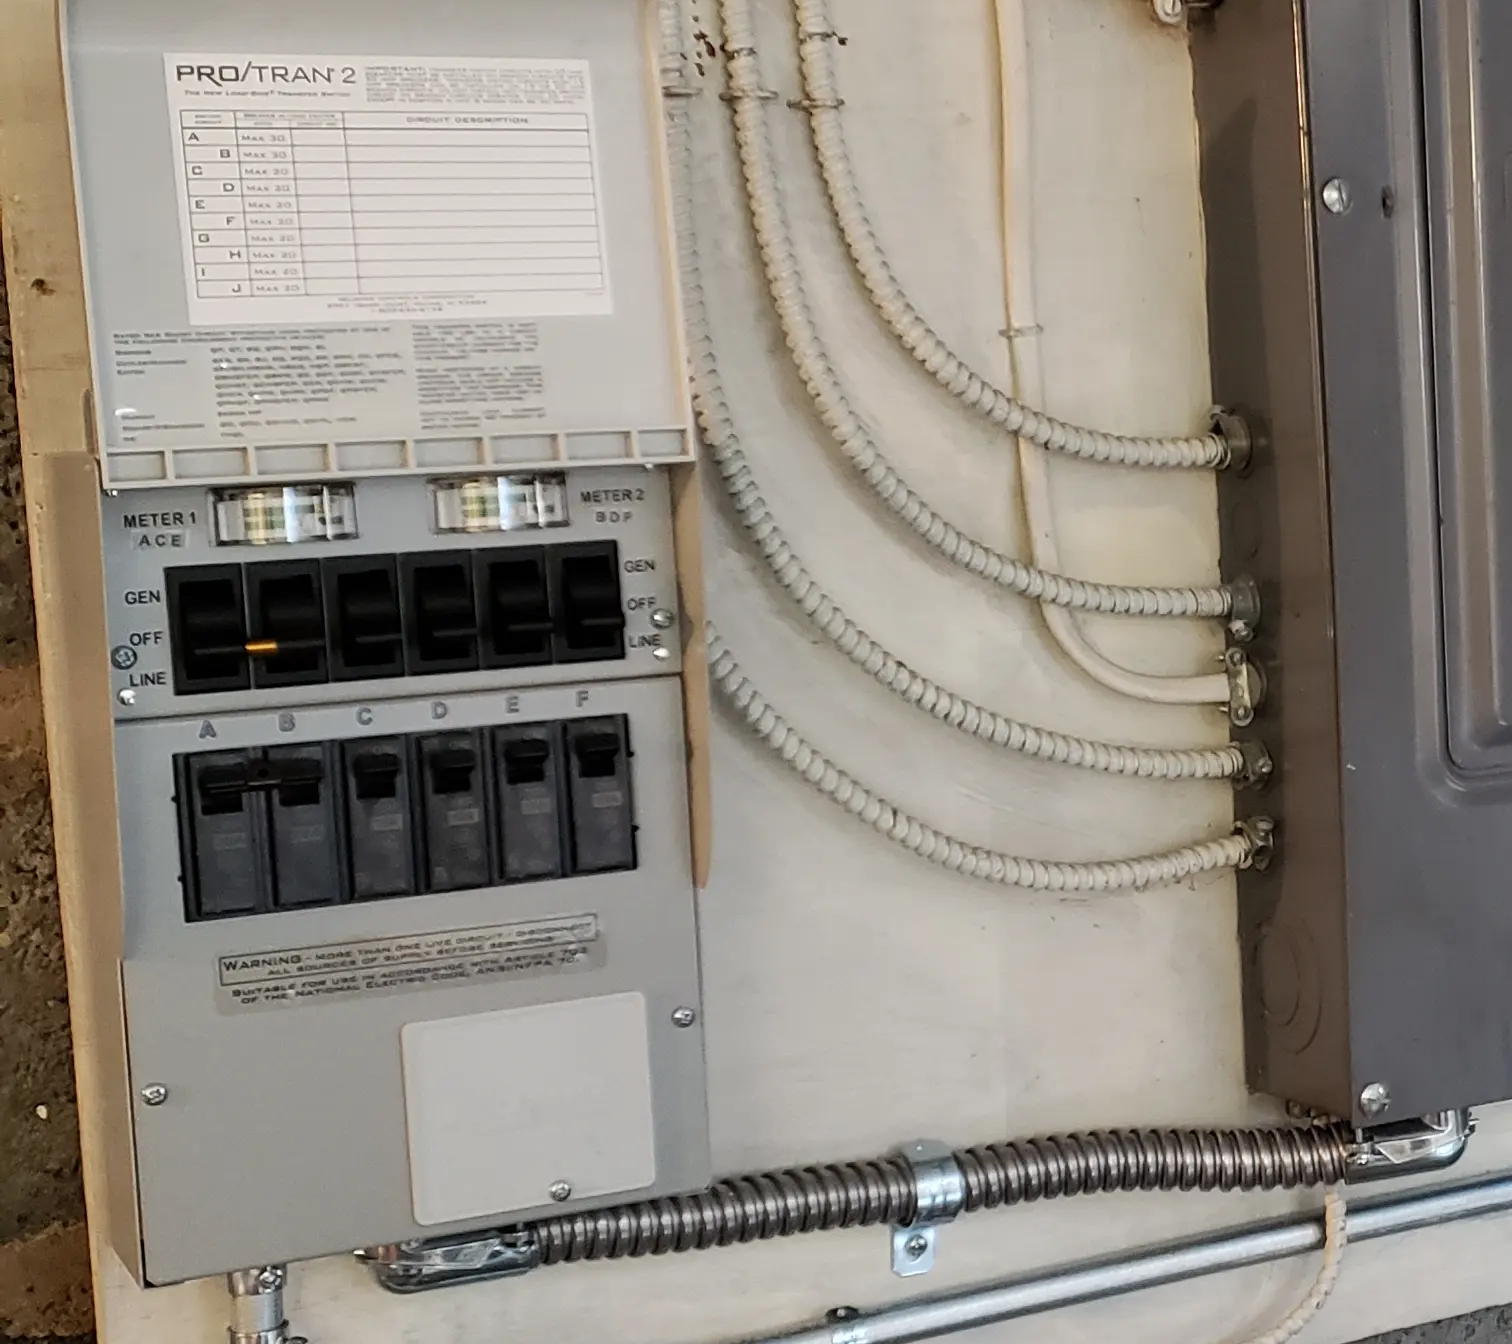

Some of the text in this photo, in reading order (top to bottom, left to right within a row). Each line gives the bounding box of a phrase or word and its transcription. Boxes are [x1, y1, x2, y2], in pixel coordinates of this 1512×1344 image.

[341, 66, 356, 84] 2
[406, 115, 529, 125] CIRCUIT DESCRIPTION
[188, 131, 200, 142] A
[219, 148, 231, 159] B
[191, 165, 203, 176] C
[222, 182, 235, 193] D
[194, 199, 206, 210] E
[226, 216, 236, 226] F
[198, 233, 210, 243] G
[229, 250, 242, 260] H
[231, 283, 242, 294] J
[580, 487, 646, 504] METER 2
[123, 511, 196, 529] METER 1
[624, 559, 656, 574] GEN
[124, 589, 161, 605] GEN
[626, 596, 657, 611] OFF
[129, 631, 164, 647] OFF
[628, 634, 662, 649] LINE
[128, 671, 167, 688] LINE
[198, 689, 590, 740] A B C D E F
[223, 954, 302, 972] WARNING
[315, 950, 353, 961] MORE
[357, 945, 391, 956] THAN
[394, 942, 421, 951] ONE
[267, 967, 292, 976] ALL
[296, 959, 357, 973] SOURCES
[361, 956, 378, 965] OF
[231, 983, 297, 997] SUITABLE
[301, 979, 327, 989] FOR
[332, 975, 358, 986] USE
[240, 996, 258, 1005] OF
[264, 992, 289, 1002] THE
[295, 985, 361, 998] NATIONAL
